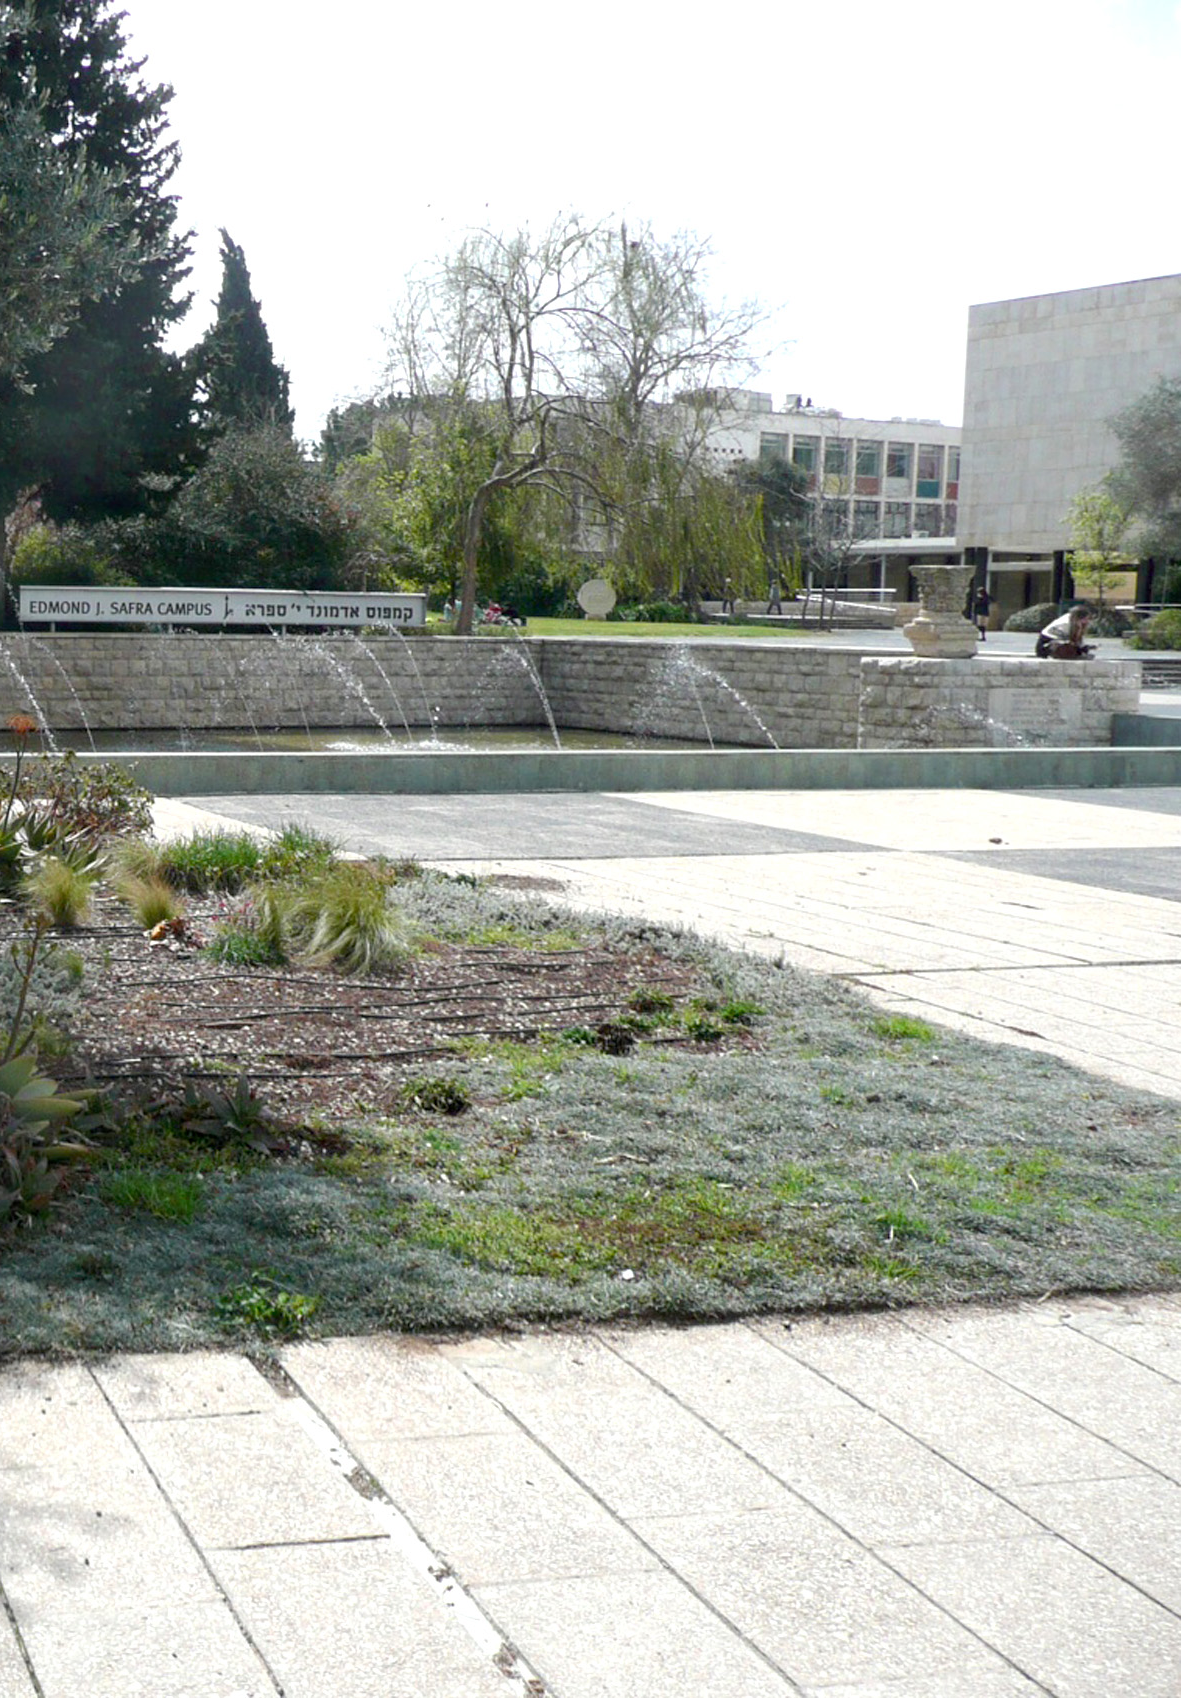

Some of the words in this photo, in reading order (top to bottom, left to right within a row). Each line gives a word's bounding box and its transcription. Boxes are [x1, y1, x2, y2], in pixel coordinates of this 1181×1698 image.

[29, 601, 91, 614] EDMOND
[96, 602, 105, 616] J.
[110, 601, 153, 615] SAFRA
[157, 602, 213, 616] CAMPUS
[245, 603, 287, 617] ספרא
[291, 603, 301, 613] י'
[306, 604, 360, 618] אדמונד
[366, 606, 414, 622] קמפוס
